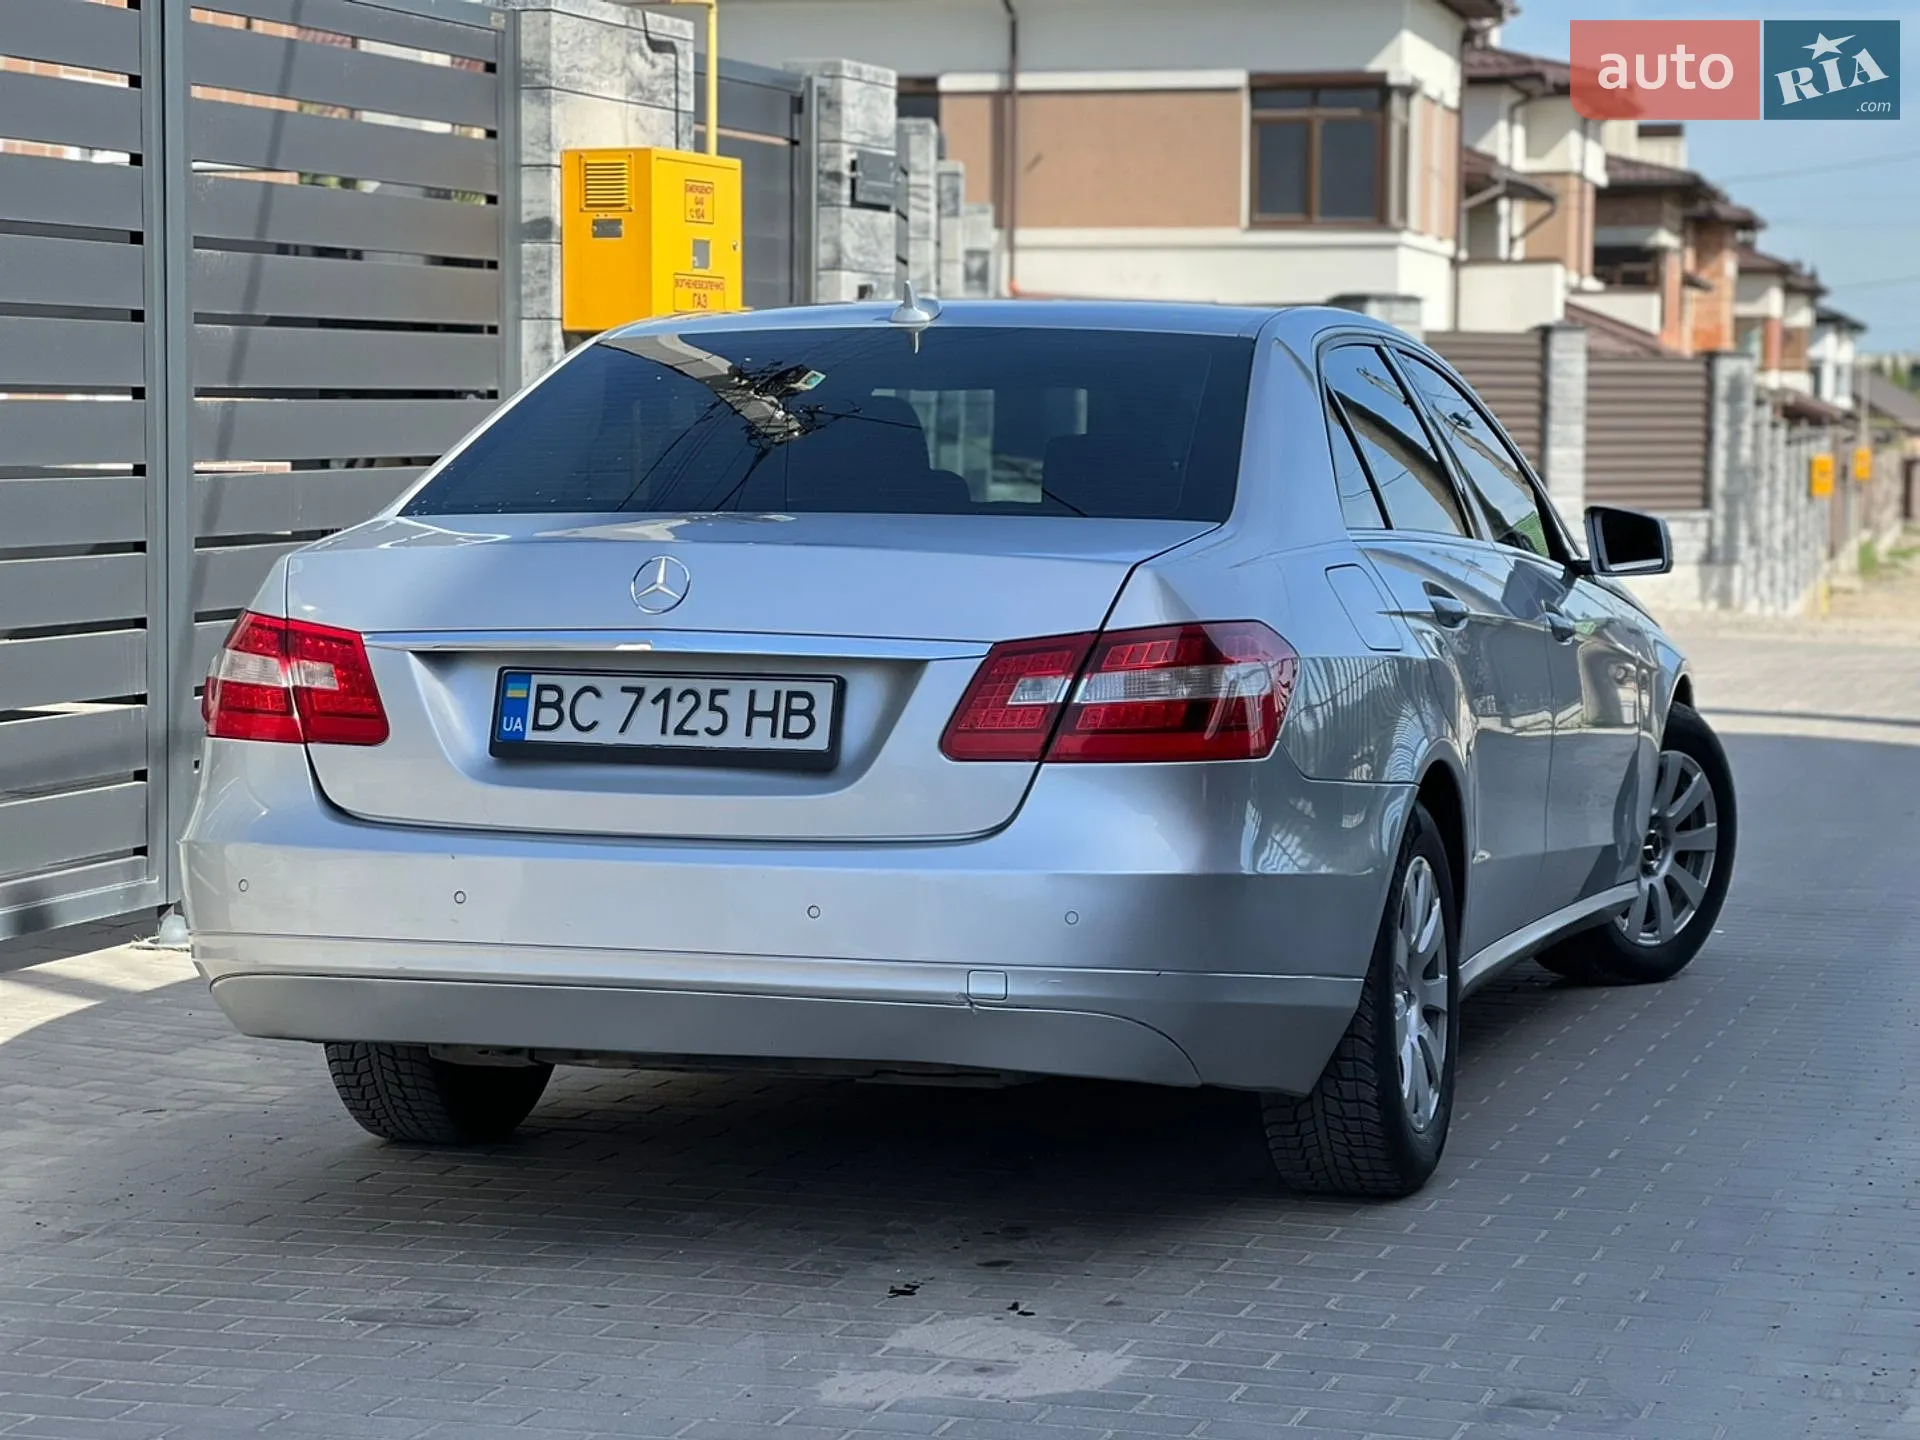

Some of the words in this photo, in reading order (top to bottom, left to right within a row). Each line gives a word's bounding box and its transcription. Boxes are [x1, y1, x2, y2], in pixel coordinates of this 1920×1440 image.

[503, 717, 523, 732] UA
[531, 684, 602, 733] BC
[618, 685, 729, 737] 7125
[745, 689, 816, 740] HB
